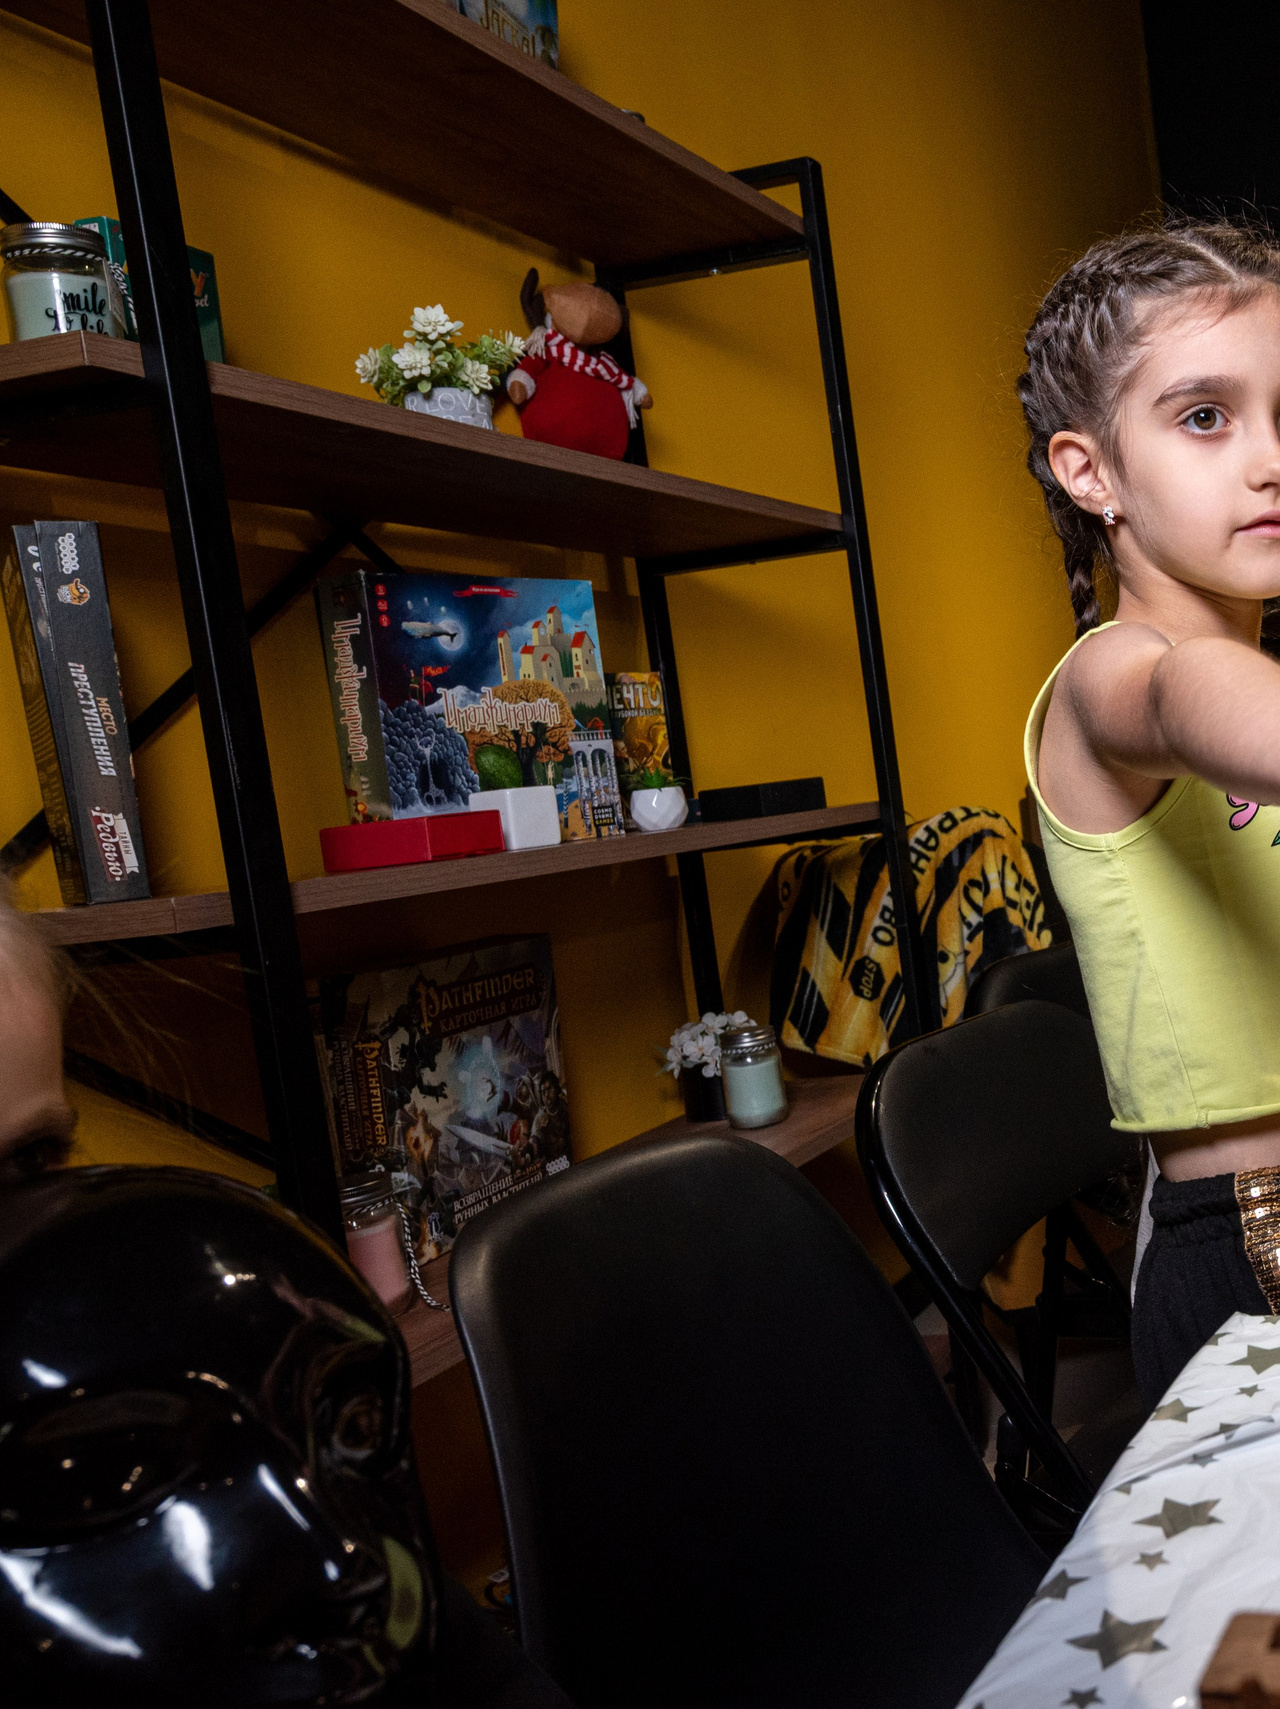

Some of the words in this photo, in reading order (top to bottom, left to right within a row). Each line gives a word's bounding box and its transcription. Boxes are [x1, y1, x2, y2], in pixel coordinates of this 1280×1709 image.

[58, 282, 106, 316] mile
[425, 392, 487, 416] LOVE
[333, 613, 368, 762] Имаджинариум
[606, 683, 662, 710] ЕЧТО
[68, 662, 117, 777] ПРЕСТУПЛЕНИЯ
[96, 697, 118, 735] МЕСТО
[437, 686, 561, 734] Имаджинариум
[91, 809, 123, 876] Редвью
[119, 831, 132, 855] ТАЙНЫ
[859, 957, 879, 999] STOP
[440, 1004, 508, 1033] КАРТОЧНАЯ
[511, 994, 538, 1014] ИГРА
[453, 1174, 514, 1213] ВОЗВРАЩЕНИЕ
[454, 1199, 490, 1225] РУННЫХ
